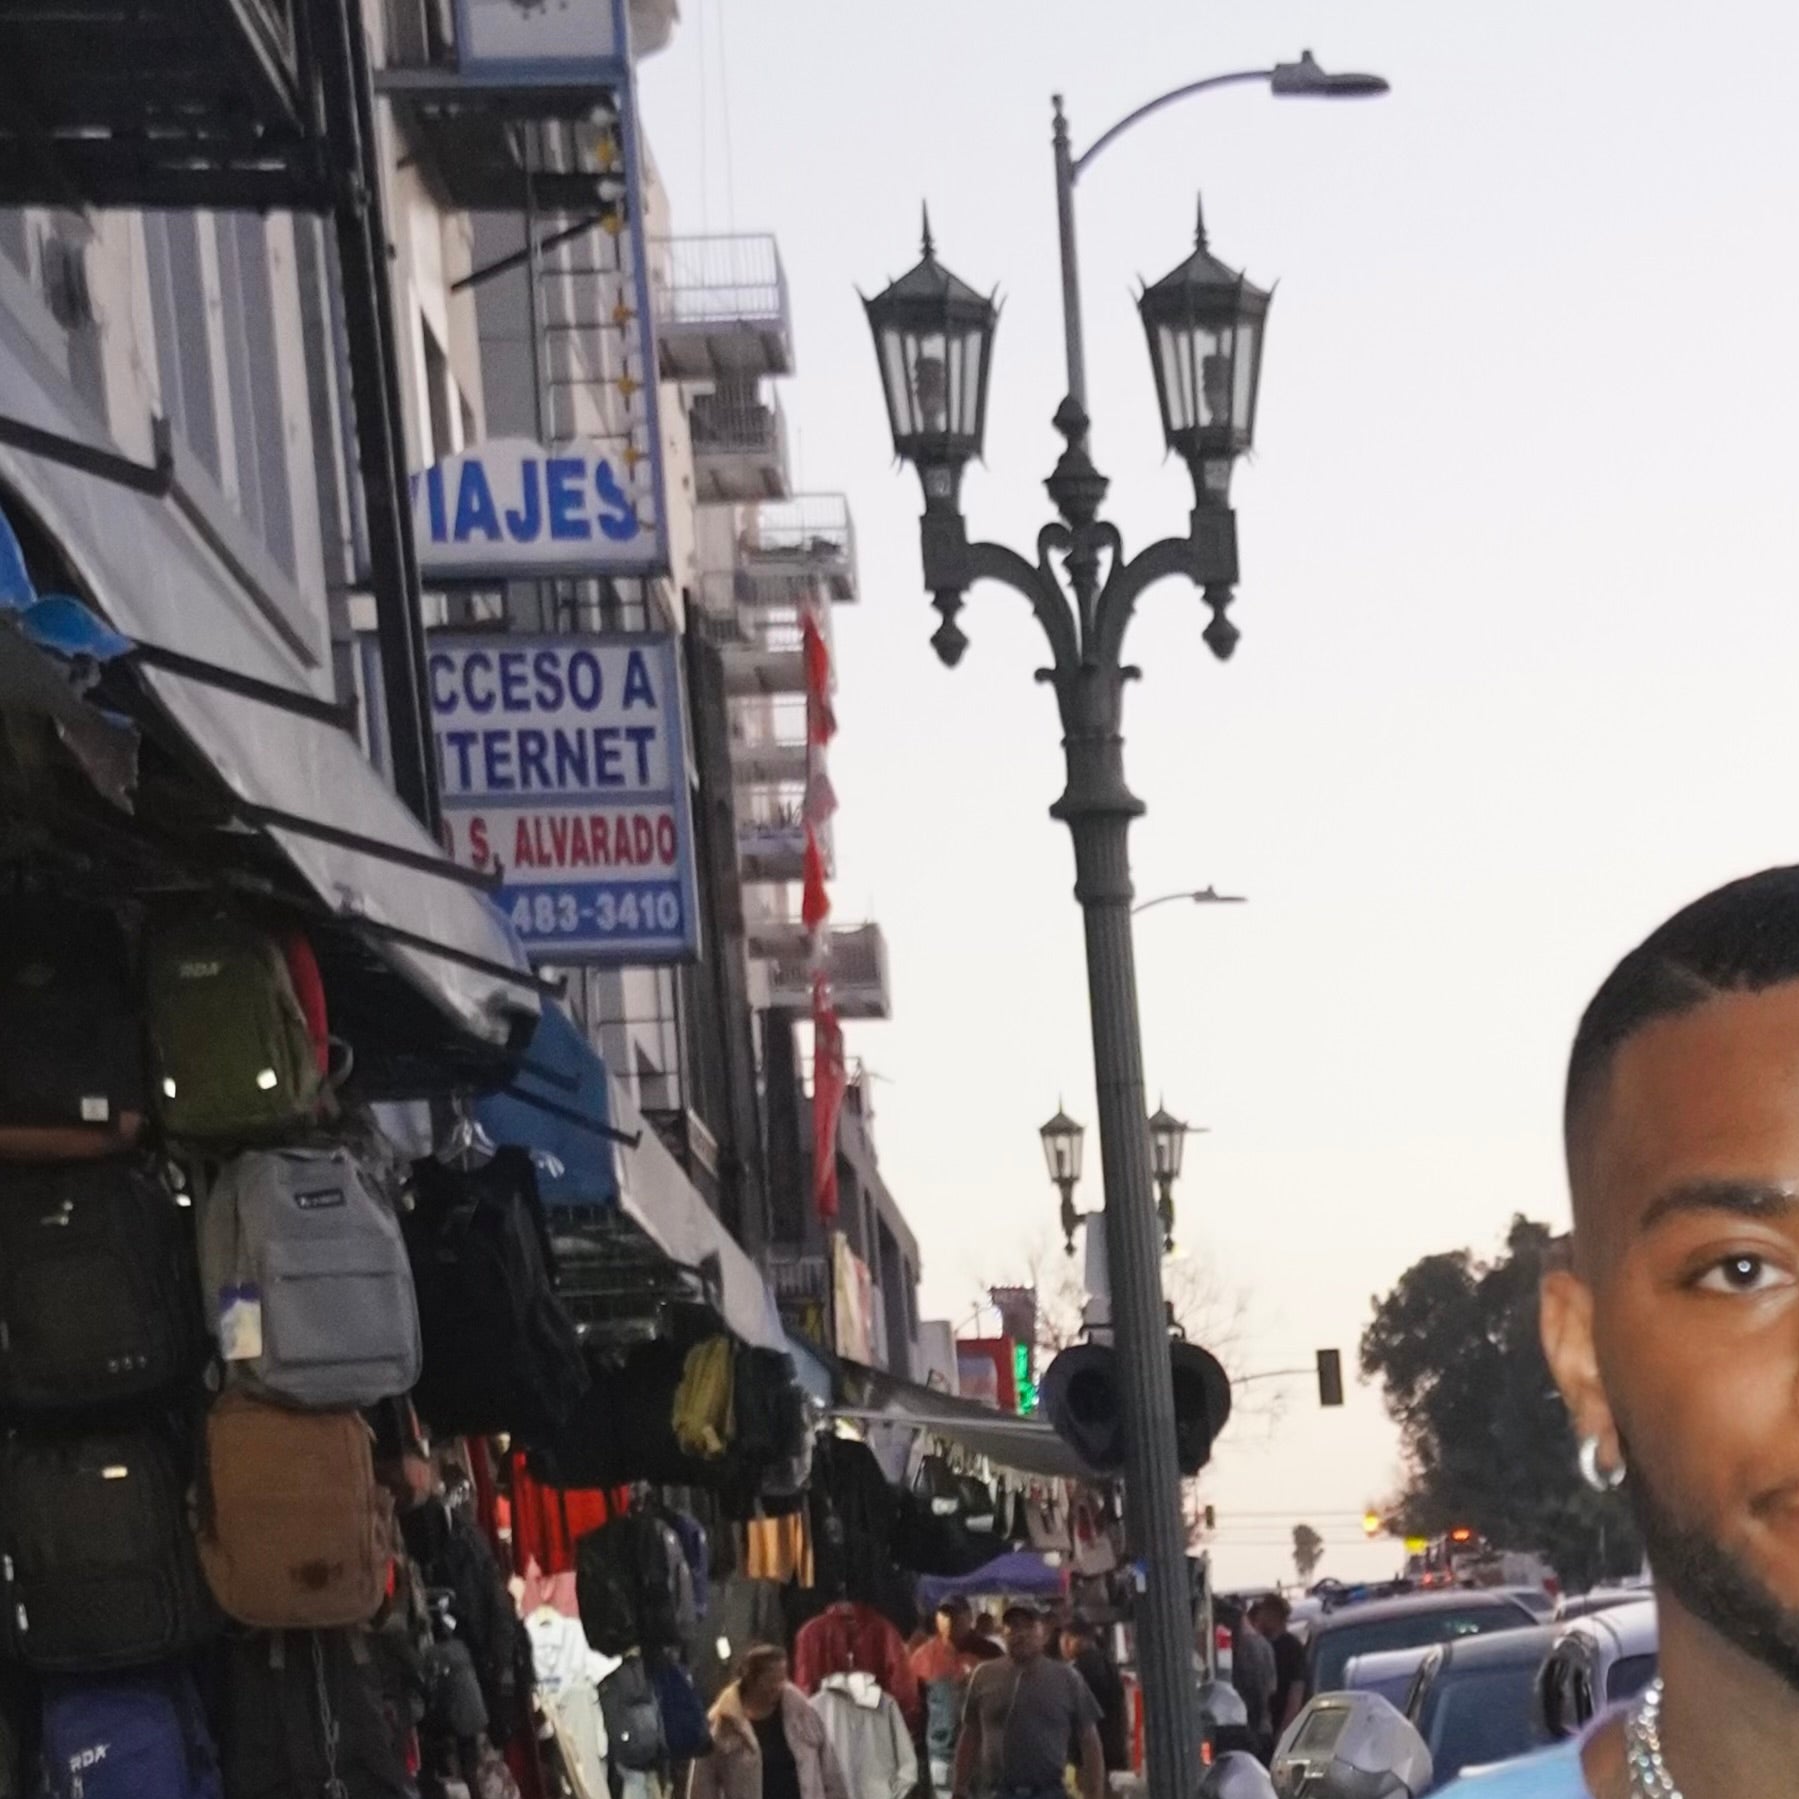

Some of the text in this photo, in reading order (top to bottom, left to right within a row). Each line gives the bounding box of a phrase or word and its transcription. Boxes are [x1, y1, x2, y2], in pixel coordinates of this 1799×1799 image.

[409, 458, 640, 543] IAJES
[621, 650, 657, 710] A
[436, 726, 656, 791] TERNET
[514, 813, 677, 868] ALVARADO
[511, 890, 680, 933] 483-3410
